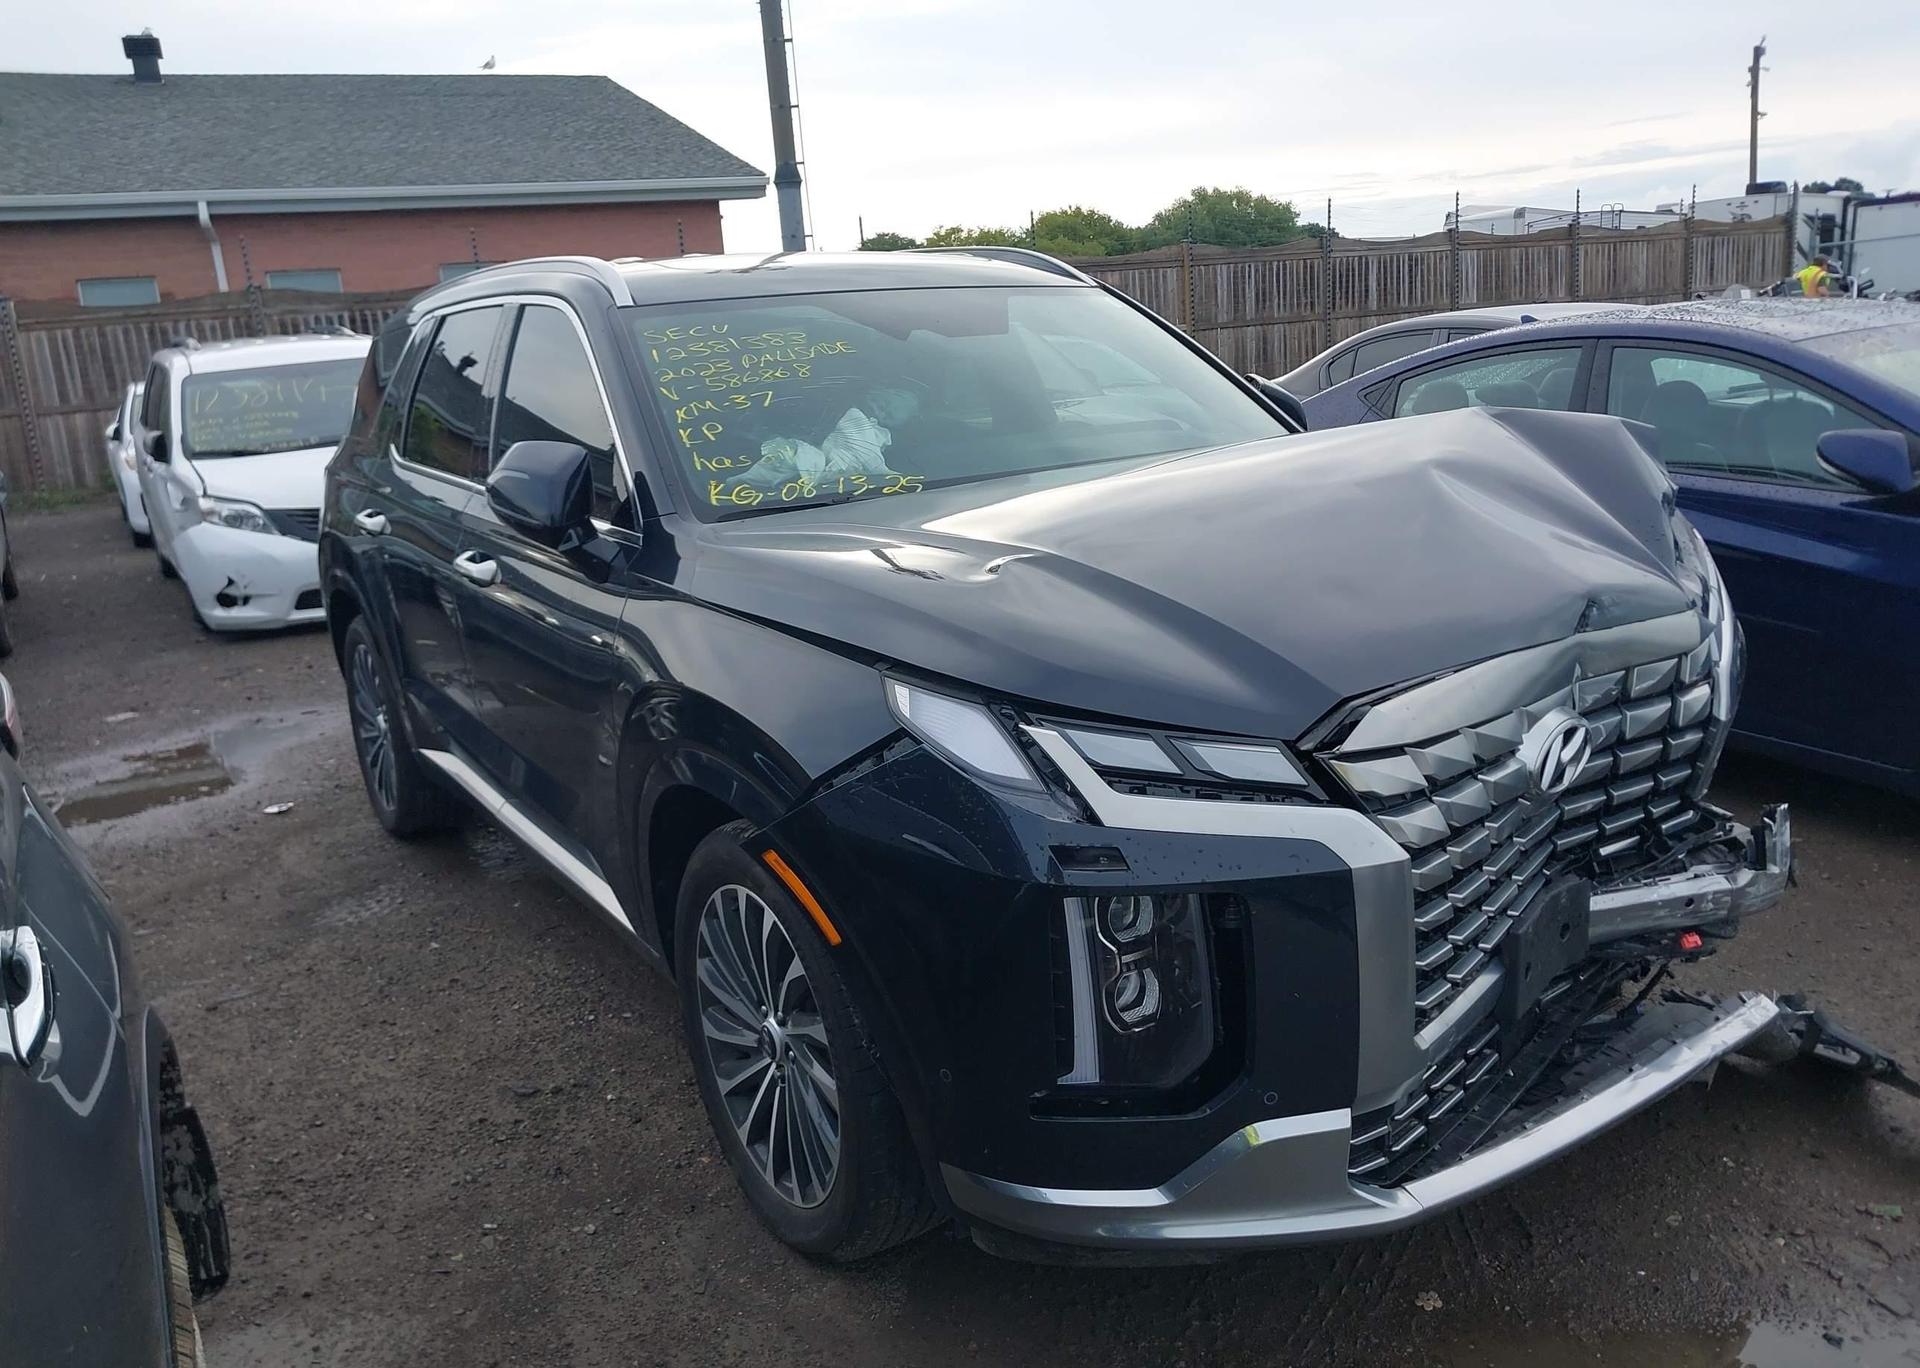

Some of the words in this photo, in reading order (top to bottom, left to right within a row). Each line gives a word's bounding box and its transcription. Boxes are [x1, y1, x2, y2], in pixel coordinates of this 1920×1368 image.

[643, 324, 729, 345] SECU
[654, 358, 734, 383] 2023
[741, 340, 857, 369] PALISADE
[678, 421, 724, 448] KP
[692, 450, 754, 473] has
